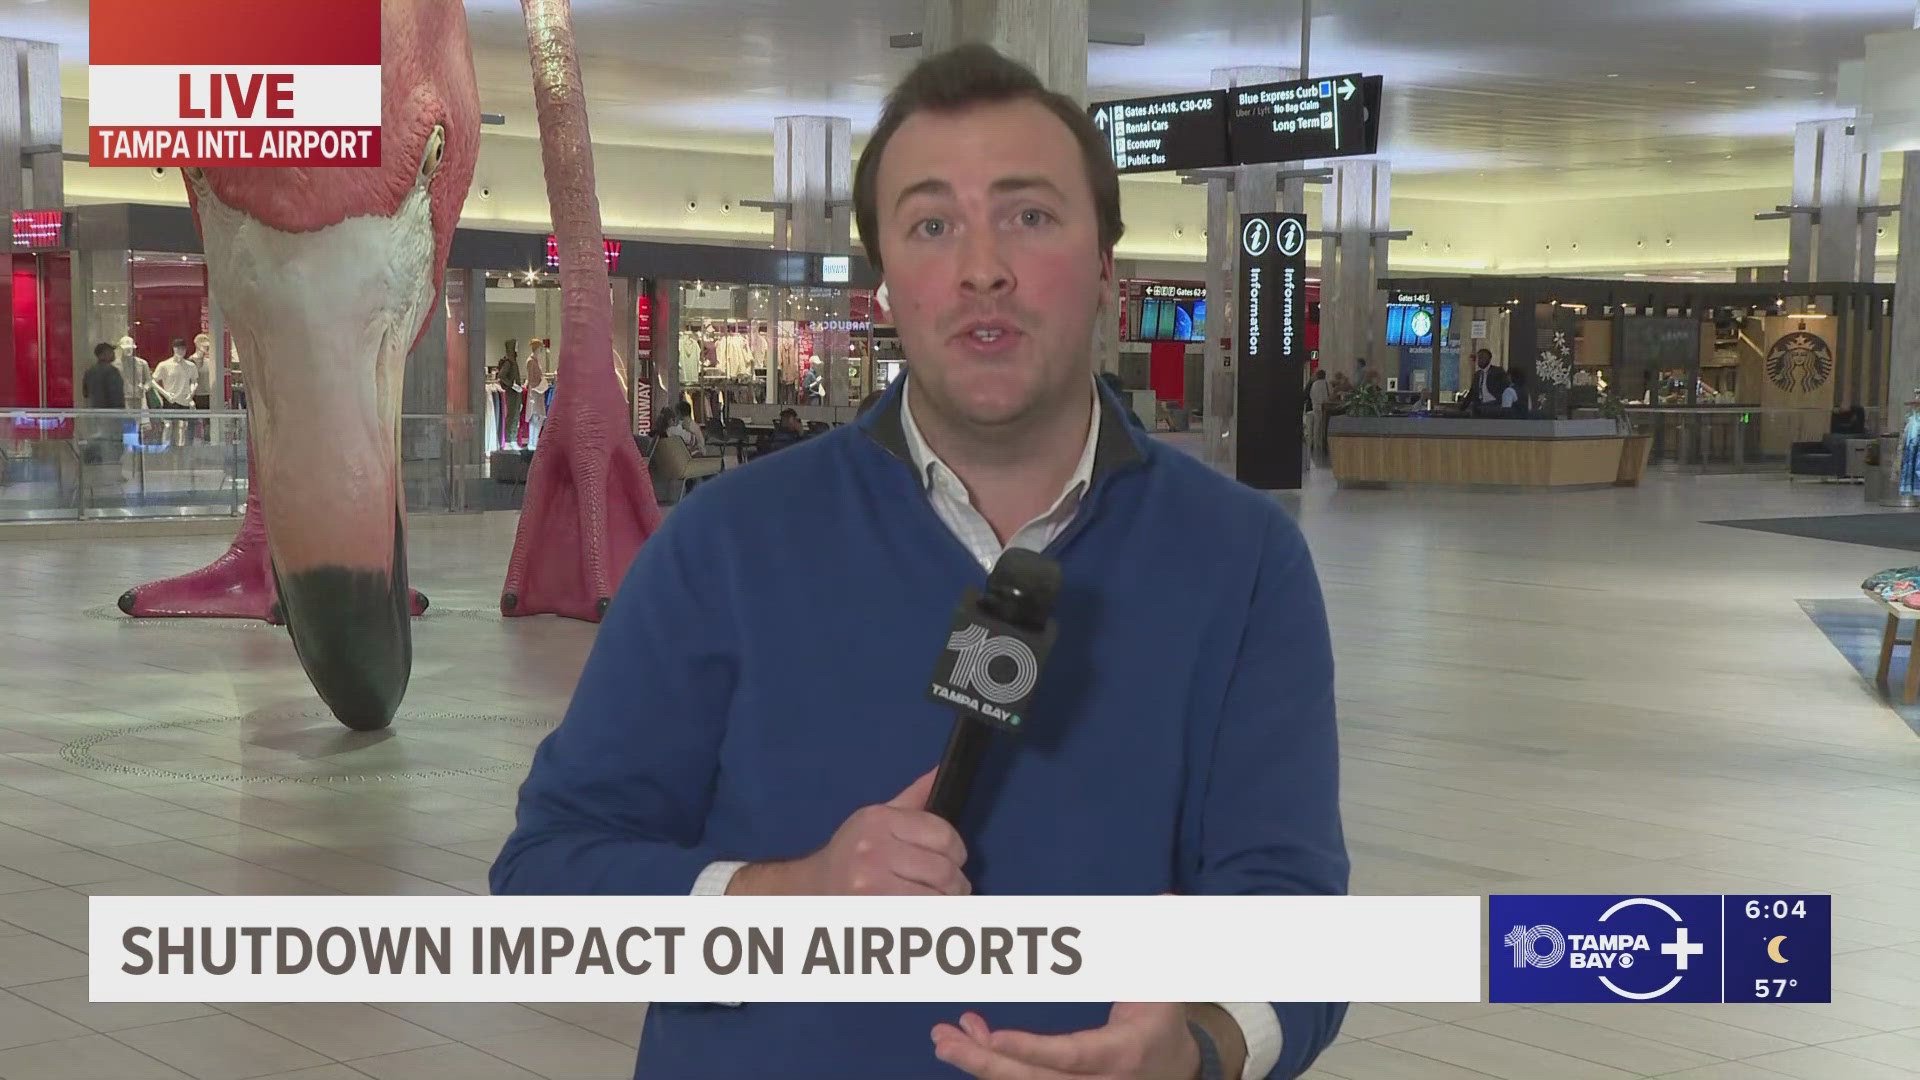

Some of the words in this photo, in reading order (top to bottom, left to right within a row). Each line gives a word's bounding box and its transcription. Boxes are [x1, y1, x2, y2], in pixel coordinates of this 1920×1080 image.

[1239, 93, 1259, 105] Blue
[1260, 89, 1294, 104] Express
[1296, 85, 1318, 98] Curb
[1125, 106, 1147, 118] Gates
[1148, 102, 1178, 115] A1-A18,
[1180, 98, 1212, 112] C30-C45
[1274, 104, 1284, 114] No
[1285, 103, 1298, 114] Bag
[1300, 101, 1319, 111] Claim
[1126, 120, 1150, 133] Rental
[1152, 120, 1169, 131] Cars
[1273, 120, 1295, 133] Long
[1297, 117, 1320, 129] Term
[1127, 138, 1161, 150] Economy
[1128, 154, 1150, 166] Public
[1152, 154, 1166, 164] Bus
[1176, 288, 1193, 296] Gates
[1398, 294, 1413, 302] Gates
[1249, 268, 1261, 355] Information
[1283, 268, 1295, 355] Information
[639, 381, 651, 437] RUNWAY
[946, 622, 1038, 704] 10
[932, 682, 979, 711] TAMPA
[981, 703, 1012, 722] BAY
